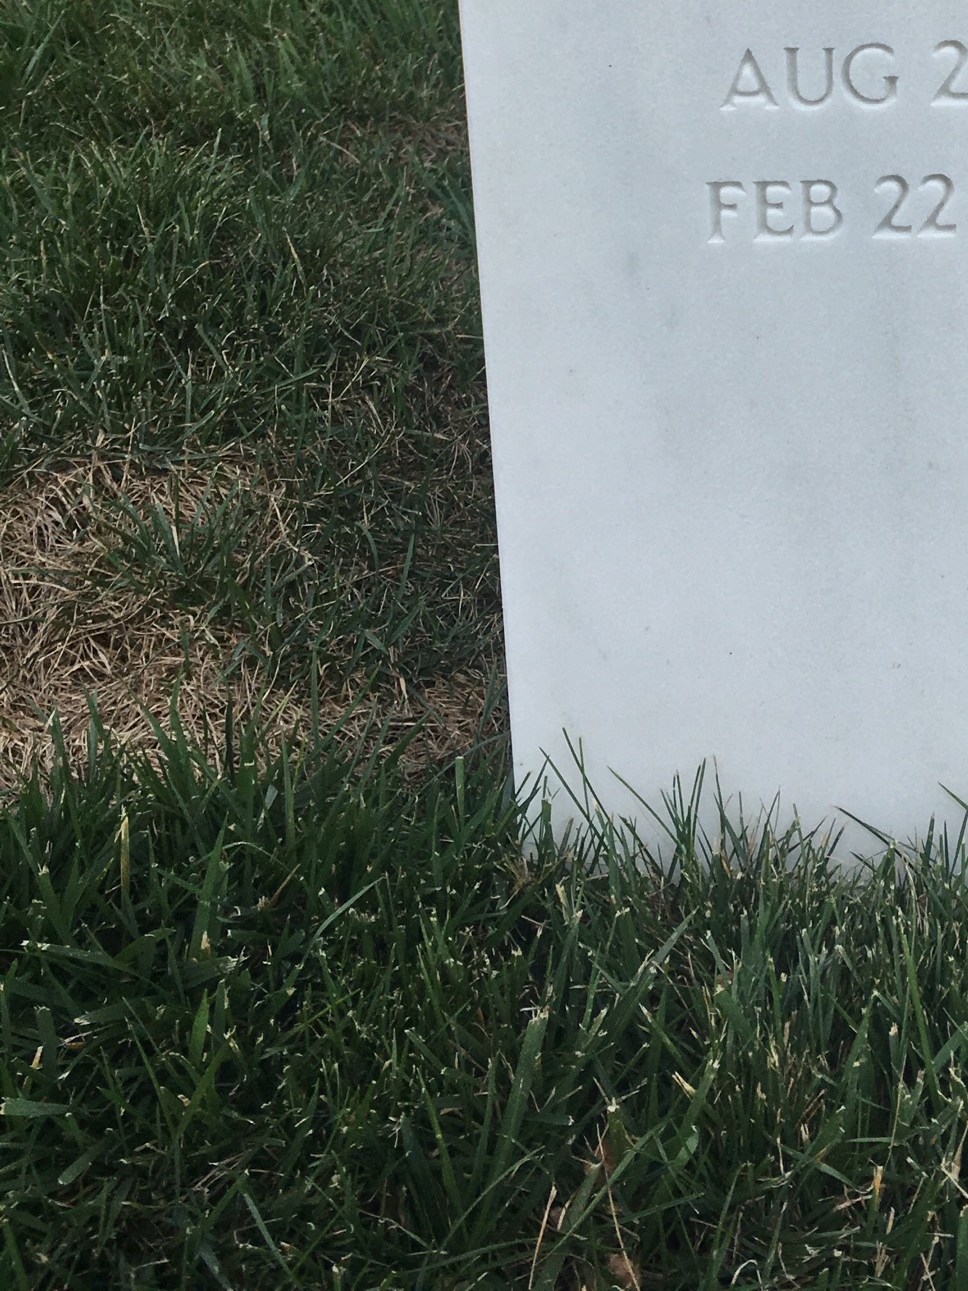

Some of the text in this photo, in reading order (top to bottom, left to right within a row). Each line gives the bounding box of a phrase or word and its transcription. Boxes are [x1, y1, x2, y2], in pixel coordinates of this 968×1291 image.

[720, 41, 899, 110] AUG
[705, 178, 844, 243] FEB
[872, 173, 957, 240] 22
